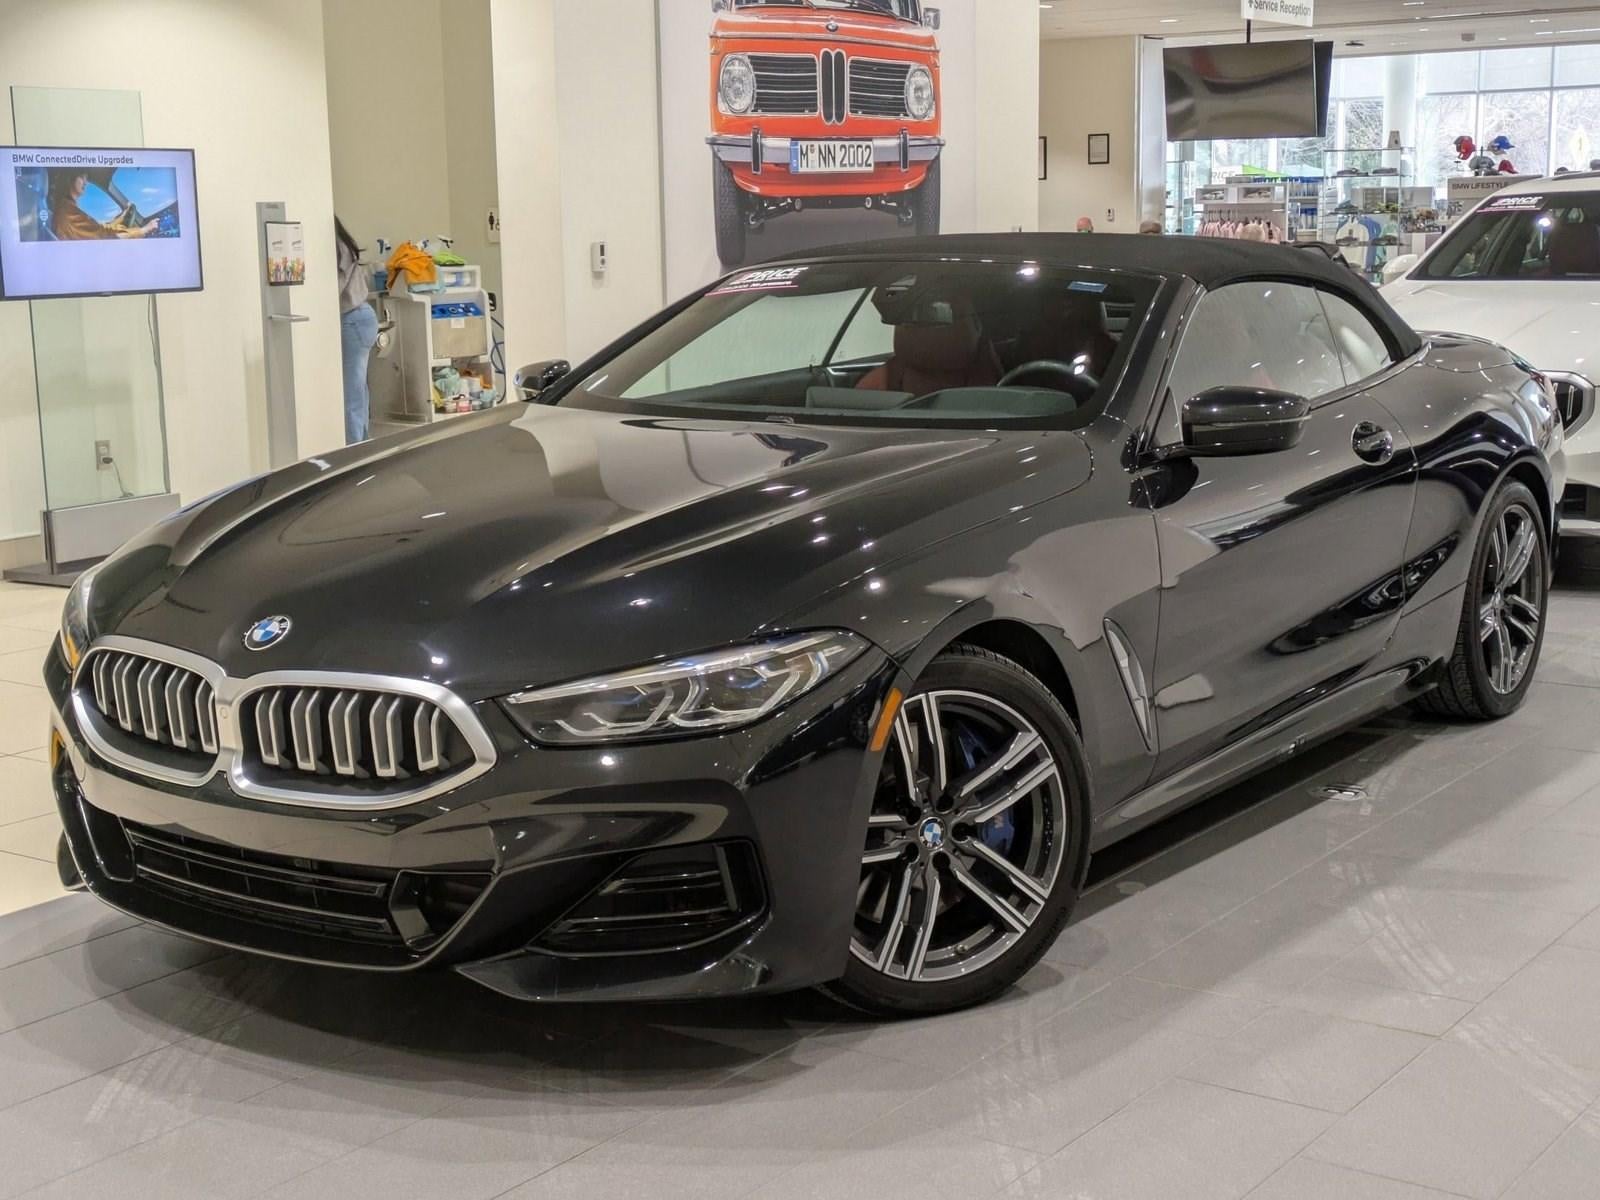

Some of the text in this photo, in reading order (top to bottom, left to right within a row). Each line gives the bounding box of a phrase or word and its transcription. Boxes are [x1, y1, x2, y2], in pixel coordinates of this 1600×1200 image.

[1254, 0, 1311, 16] Service Reception
[12, 154, 134, 166] BMW ConnectedDrive Upgrades
[818, 144, 836, 168] NN
[839, 144, 872, 168] 2002
